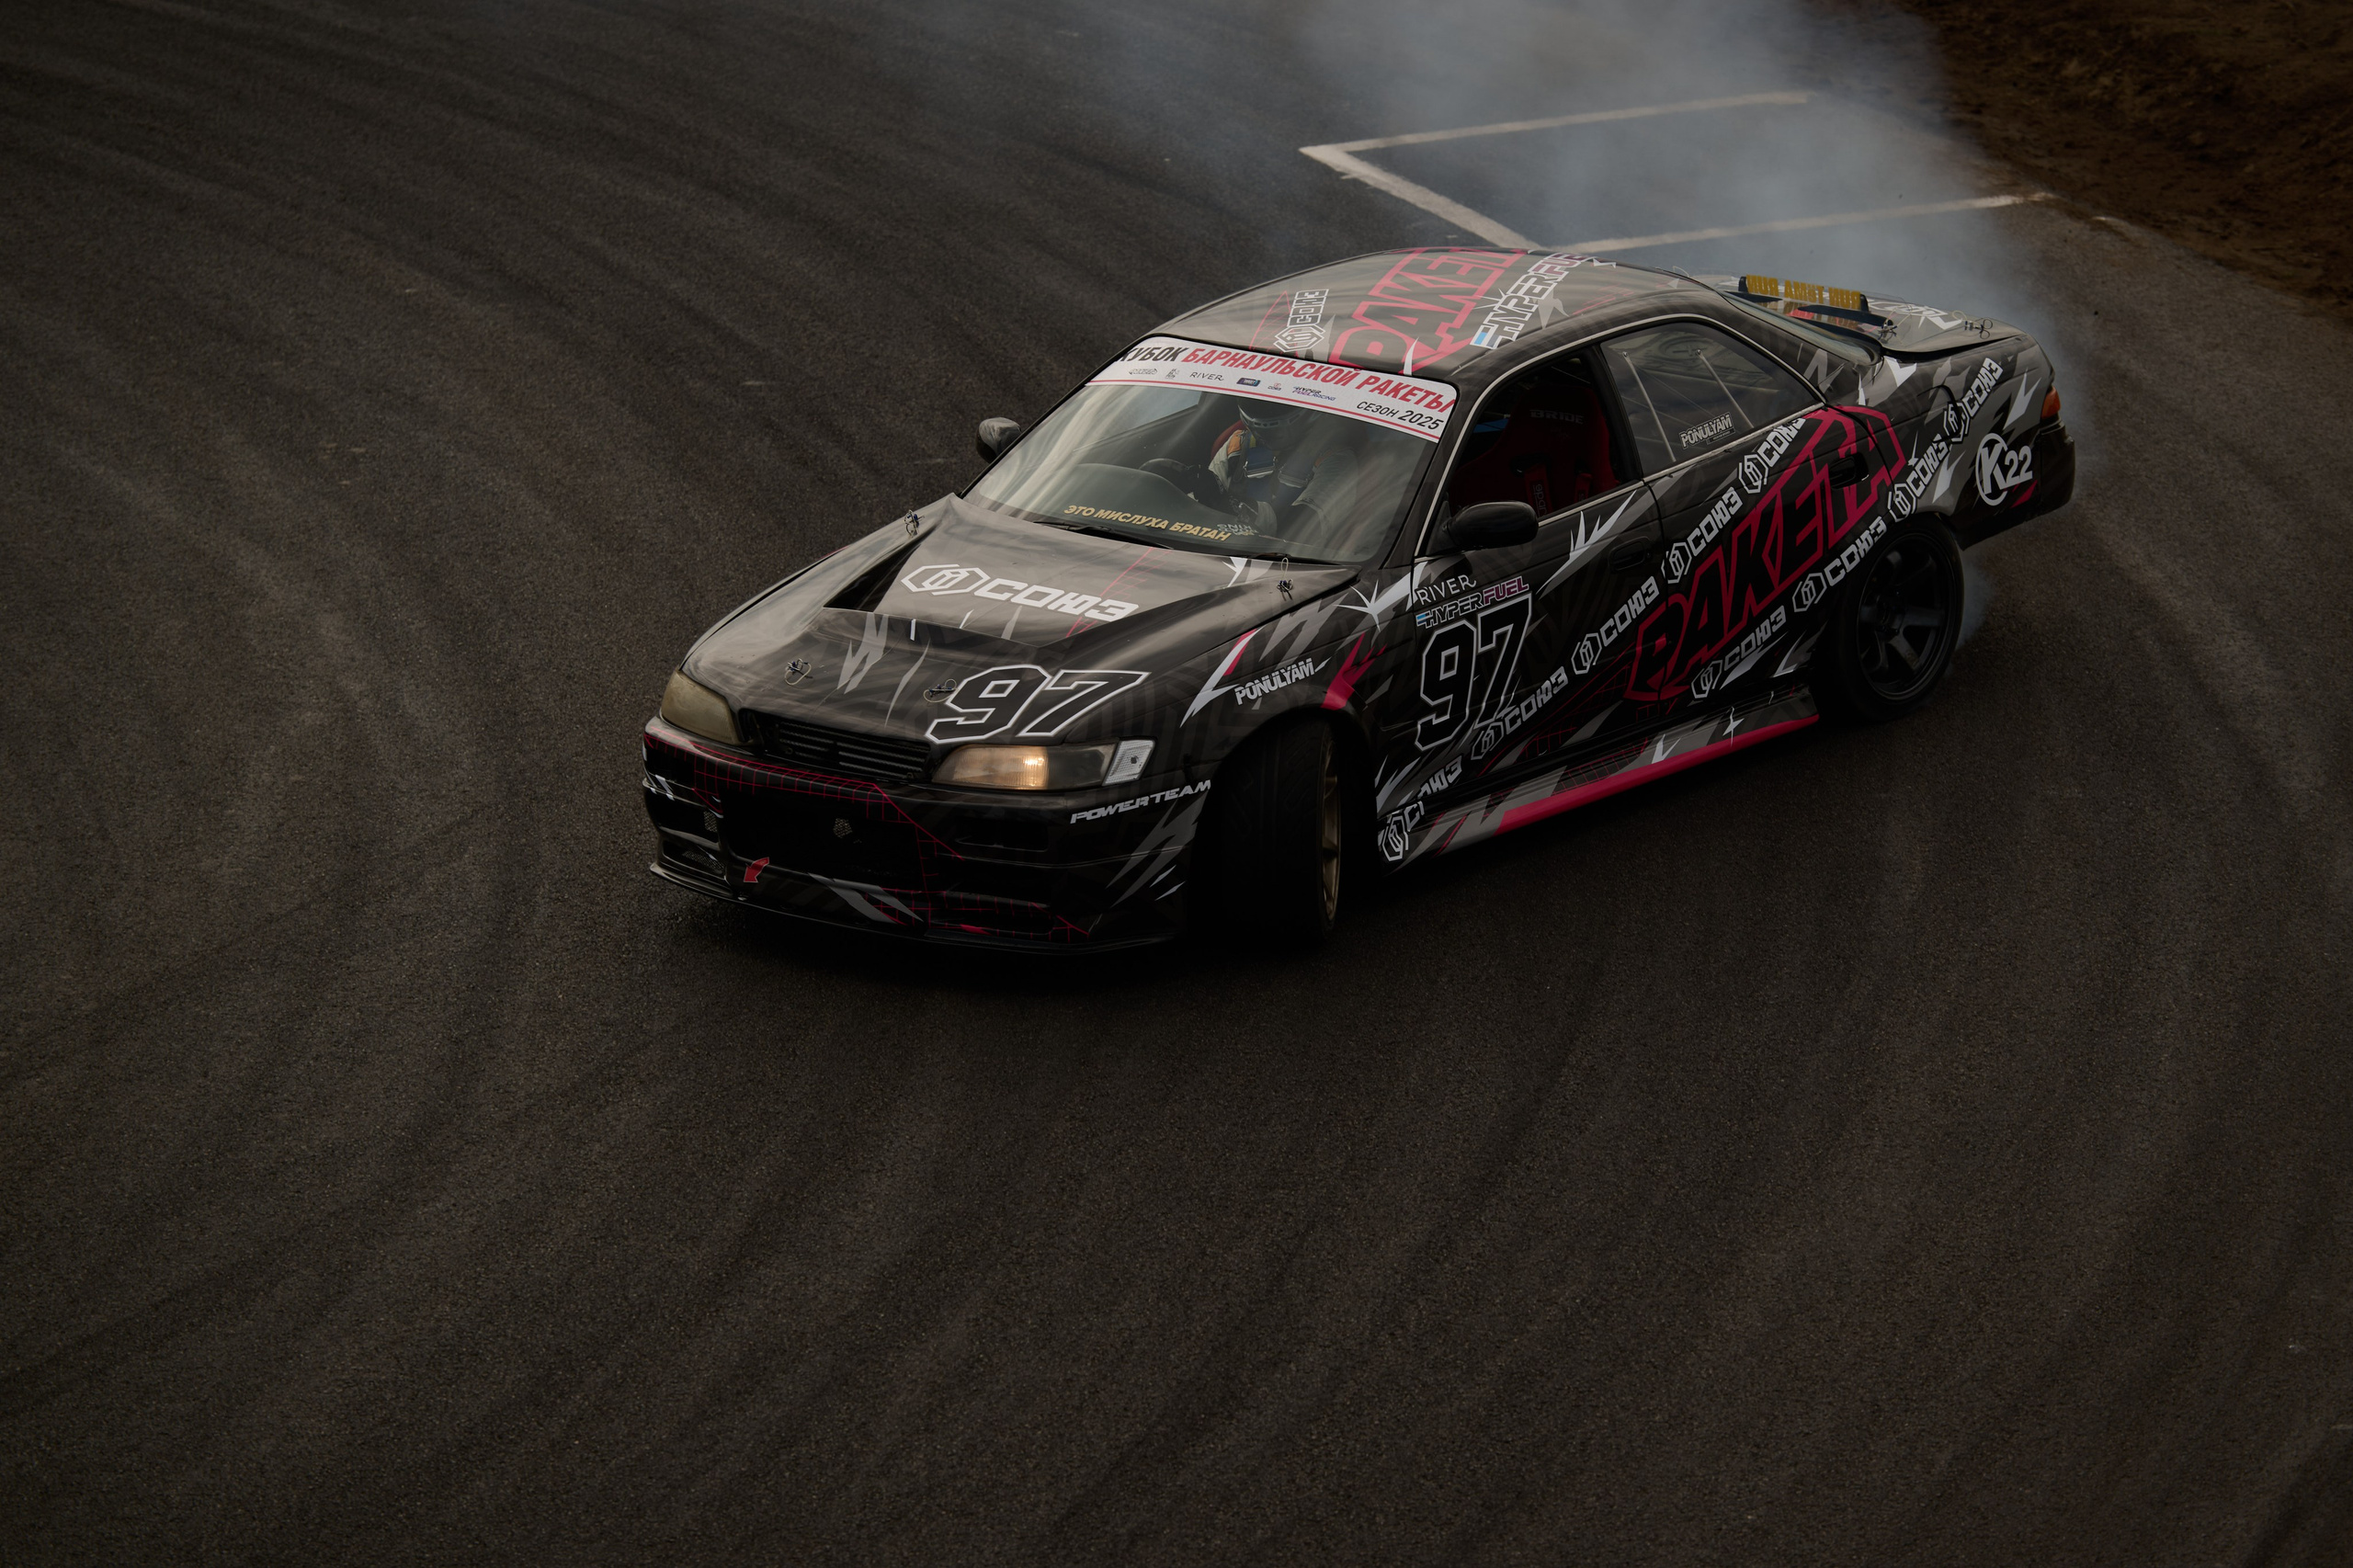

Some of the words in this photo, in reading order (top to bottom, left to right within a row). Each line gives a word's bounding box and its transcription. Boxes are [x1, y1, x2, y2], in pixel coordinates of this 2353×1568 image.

[1287, 289, 1329, 328] СОЮЗ
[1471, 253, 1589, 349] HYPERFUE
[1181, 347, 1362, 387] БАРНАУЛЬСКОЙ
[1356, 375, 1456, 414] РАКЕТЫ
[1189, 371, 1225, 381] RIVER
[1962, 358, 2004, 418] СОЮЗ
[1357, 401, 1399, 417] СЕЗОН
[1397, 410, 1444, 430] 2025
[1529, 409, 1584, 425] BRIDE
[1680, 414, 1733, 449] PONULYAM
[1906, 434, 1950, 497] СОЮЗ
[1979, 441, 2033, 495] K22
[1063, 505, 1095, 517] ЭТО
[1094, 509, 1169, 530] МИСЛУХА
[1169, 521, 1233, 542] БРАТАН
[1533, 483, 1548, 515] spar
[1687, 487, 1744, 557] СОЮЗ
[1824, 516, 1887, 587] СОЮЗ
[974, 578, 1140, 622] СОЮЗ
[1415, 574, 1477, 606] RIVER
[1415, 575, 1529, 629] HYPERFUEL
[1600, 576, 1660, 647] СОЮЗ
[1723, 605, 1787, 672] СОЮЗ
[1234, 657, 1315, 705] PONULYAM
[1414, 593, 1533, 752] 97
[925, 664, 1152, 744] 97
[1505, 665, 1569, 737] СОЮЗ
